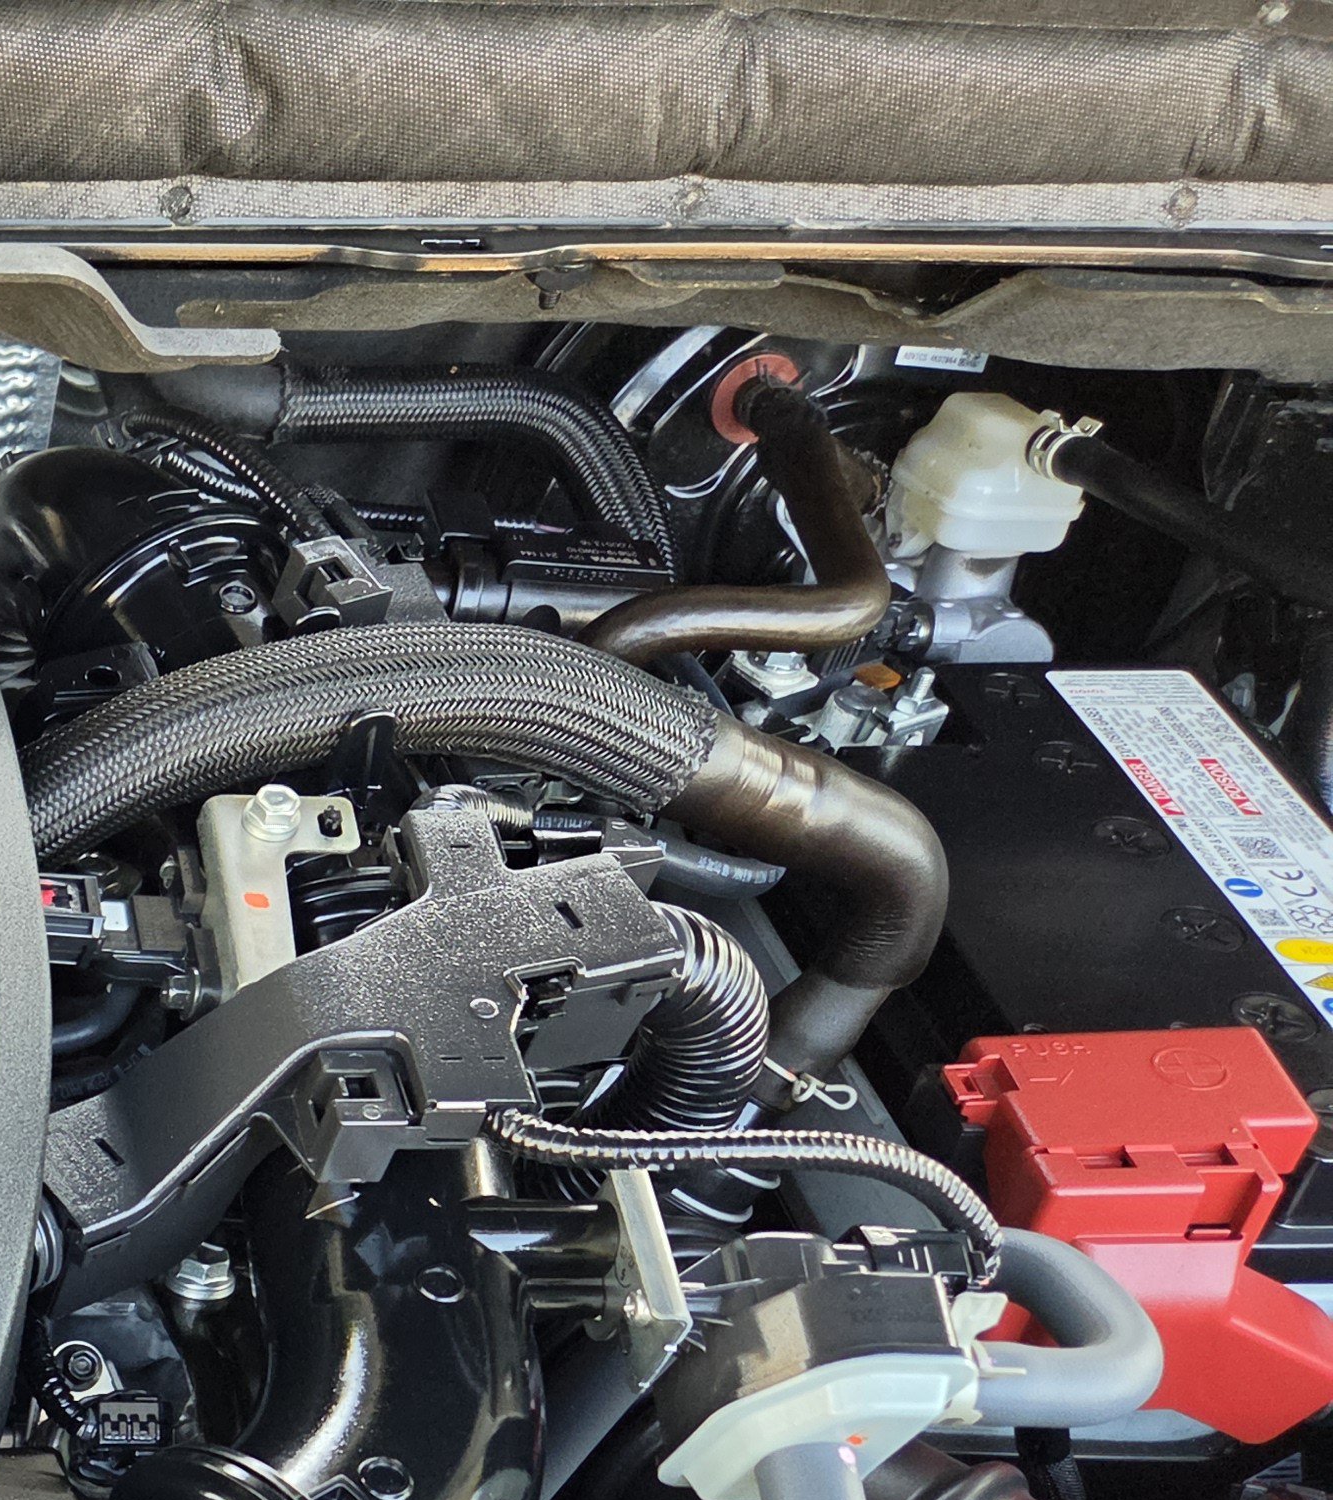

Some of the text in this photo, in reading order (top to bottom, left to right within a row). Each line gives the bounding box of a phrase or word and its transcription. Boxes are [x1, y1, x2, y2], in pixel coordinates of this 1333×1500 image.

[1126, 763, 1173, 799] DANGER
[1200, 763, 1251, 799] POISON
[1008, 1040, 1092, 1058] PUSH
